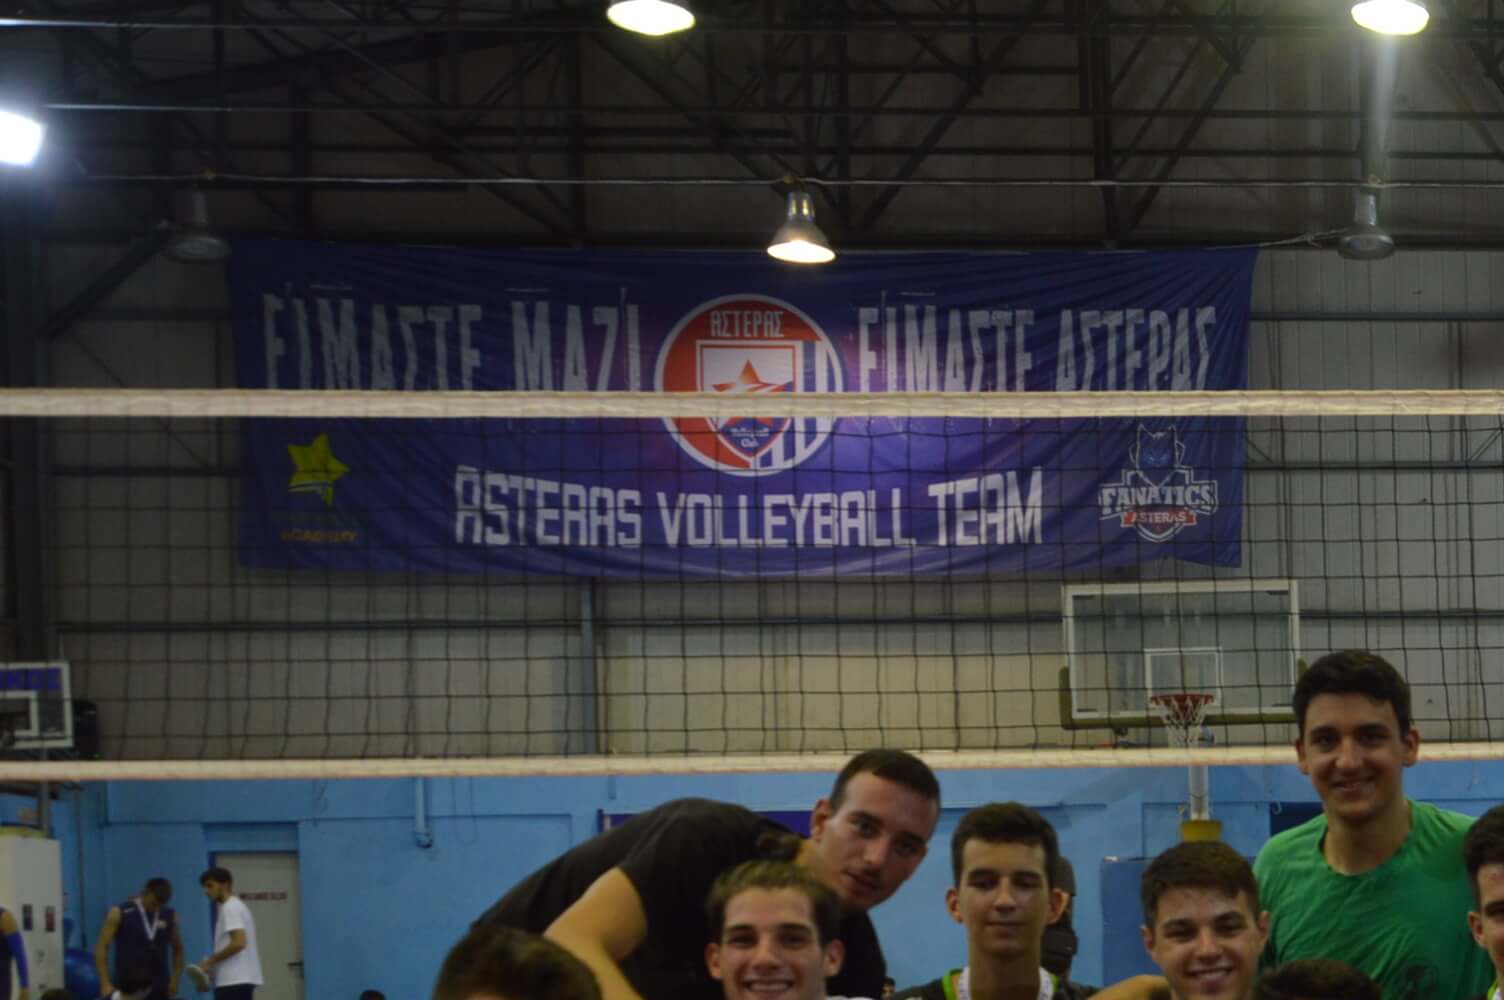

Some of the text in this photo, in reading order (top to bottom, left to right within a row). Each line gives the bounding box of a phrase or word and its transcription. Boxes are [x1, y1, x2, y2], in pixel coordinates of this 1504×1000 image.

[455, 464, 1043, 549] ASTERAS VOLLEYBALL TEAM
[1101, 485, 1213, 515] FANATICS
